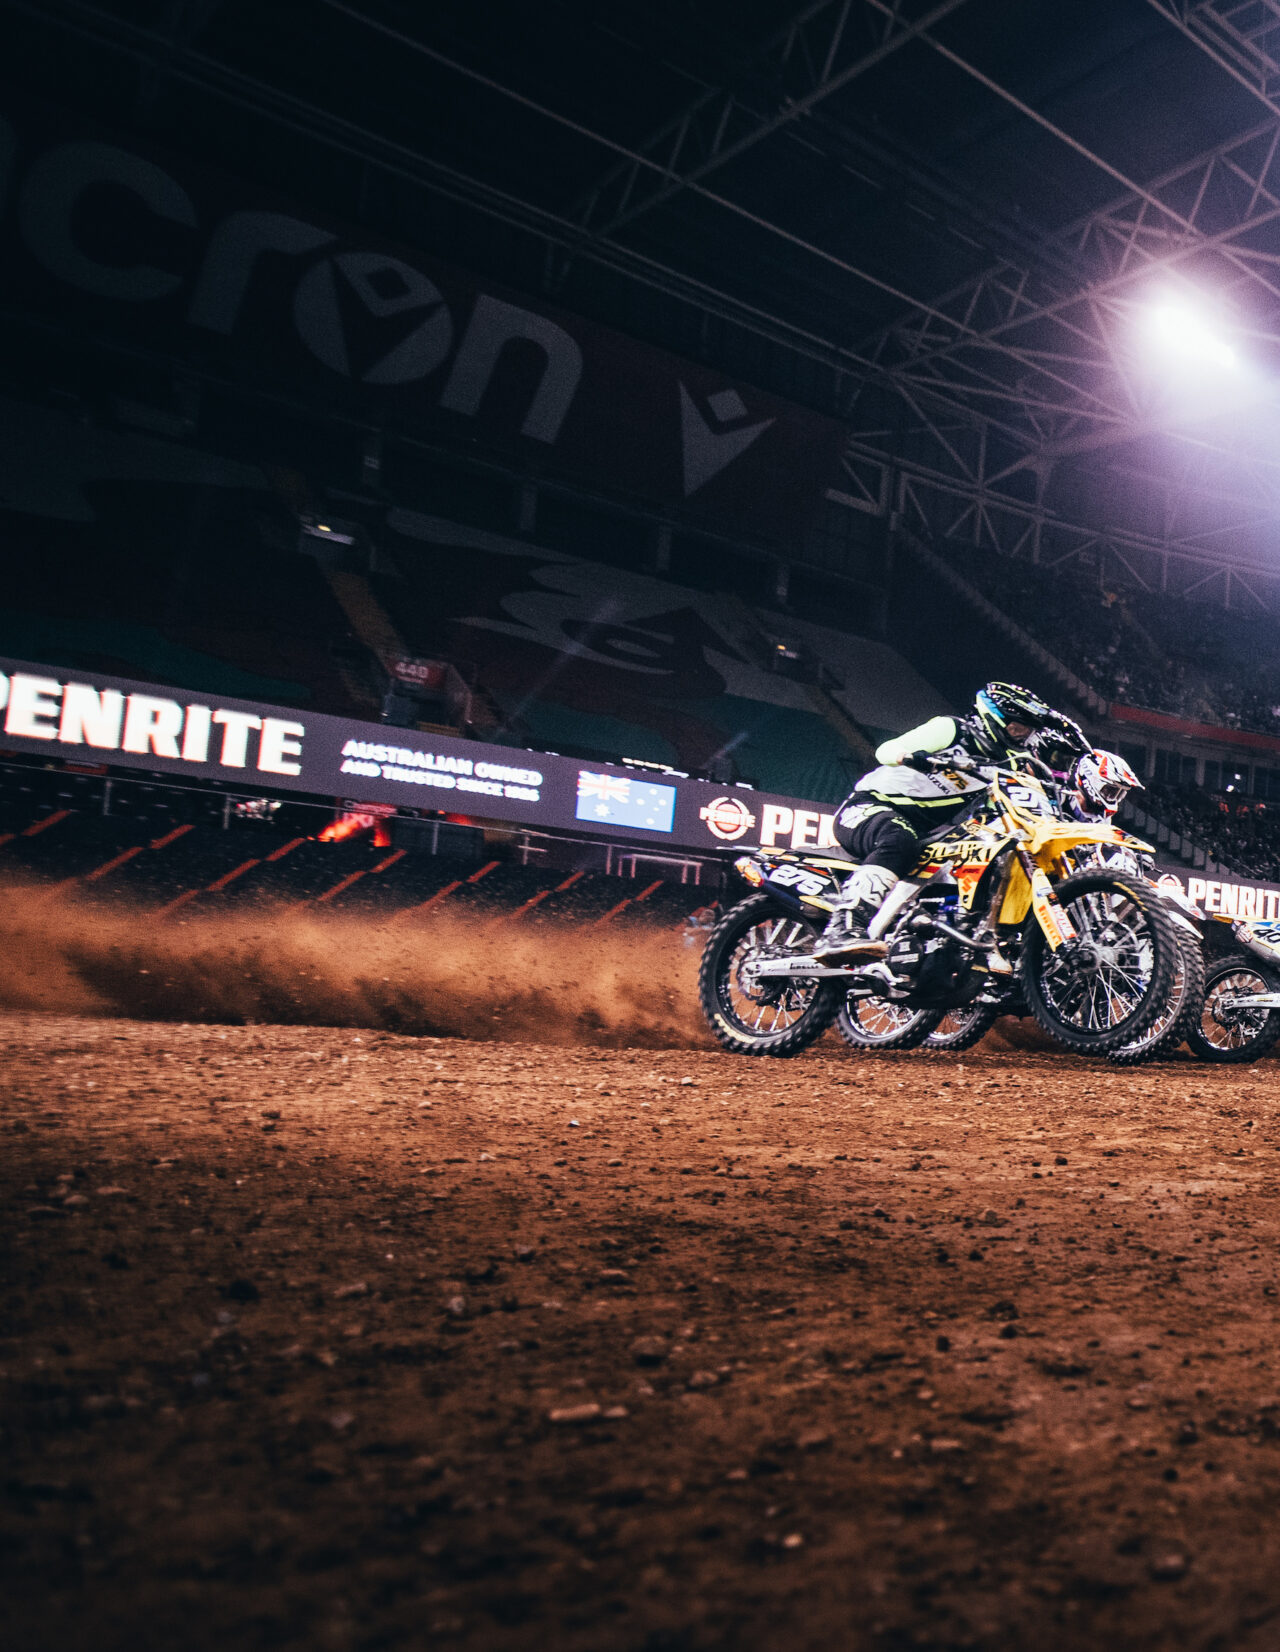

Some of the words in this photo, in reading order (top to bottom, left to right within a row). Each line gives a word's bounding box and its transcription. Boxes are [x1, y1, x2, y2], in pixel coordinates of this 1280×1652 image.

[0, 112, 583, 445] cron
[0, 669, 305, 776] ENRITE
[340, 759, 382, 777] AND
[382, 765, 456, 788] TRUSTED
[456, 778, 503, 796] SINCE
[341, 740, 474, 775] AUSTRALIAN
[474, 762, 543, 786] OWNED
[926, 772, 951, 795] UZUKI
[759, 803, 840, 849] PEN
[768, 864, 832, 896] 275
